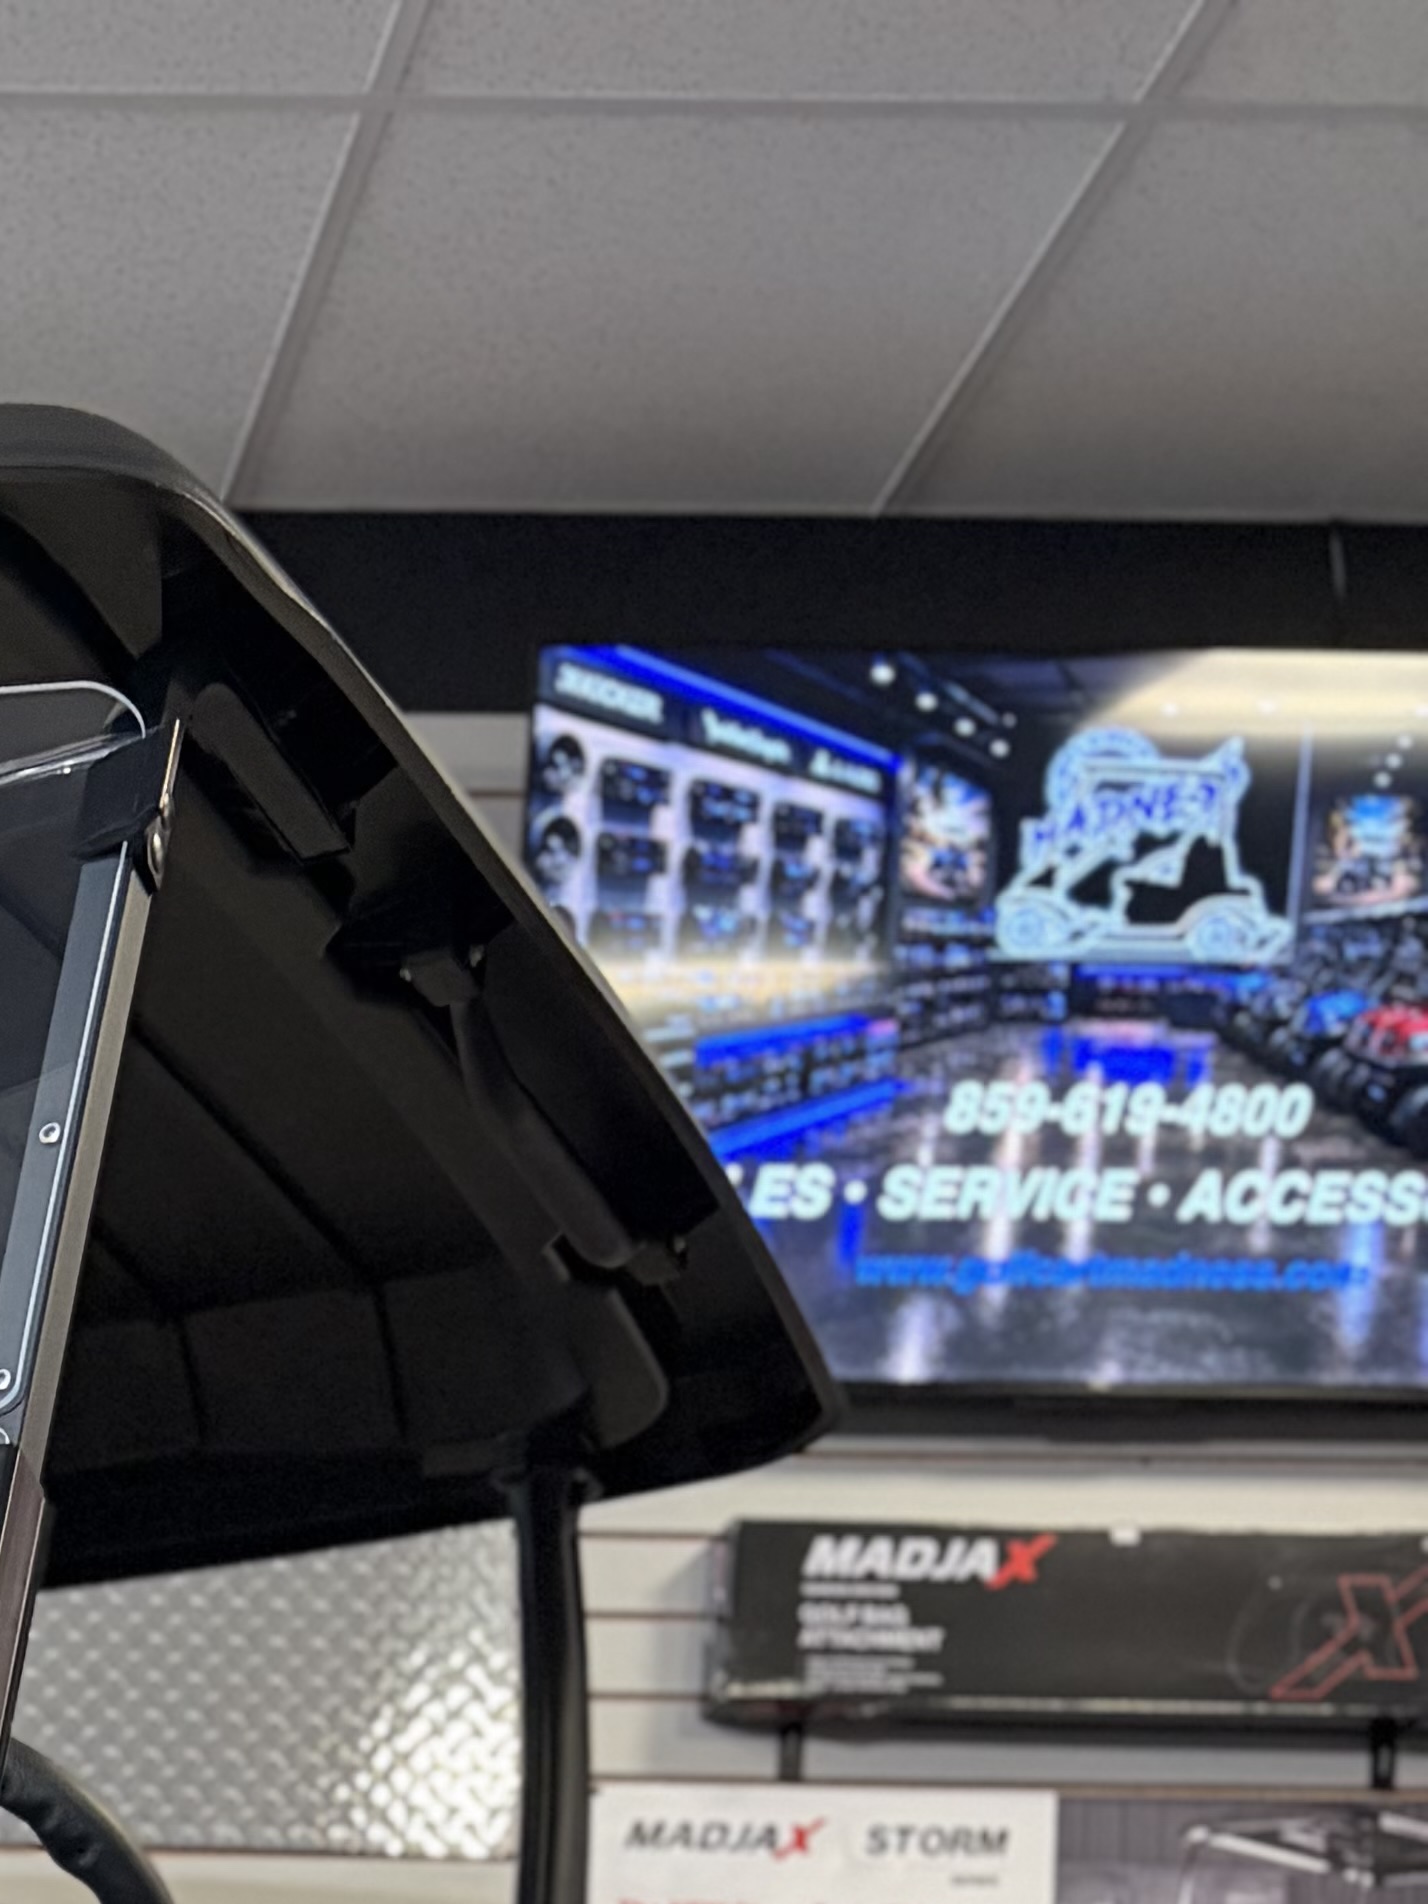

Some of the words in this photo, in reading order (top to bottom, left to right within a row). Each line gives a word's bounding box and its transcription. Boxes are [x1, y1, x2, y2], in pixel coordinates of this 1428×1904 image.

[944, 1080, 1314, 1139] 859-619-4800
[876, 1166, 1141, 1222] SERVICE
[802, 1532, 1056, 1590] MADJAX
[624, 1817, 827, 1861] MADJAX
[866, 1822, 1010, 1858] STORM
